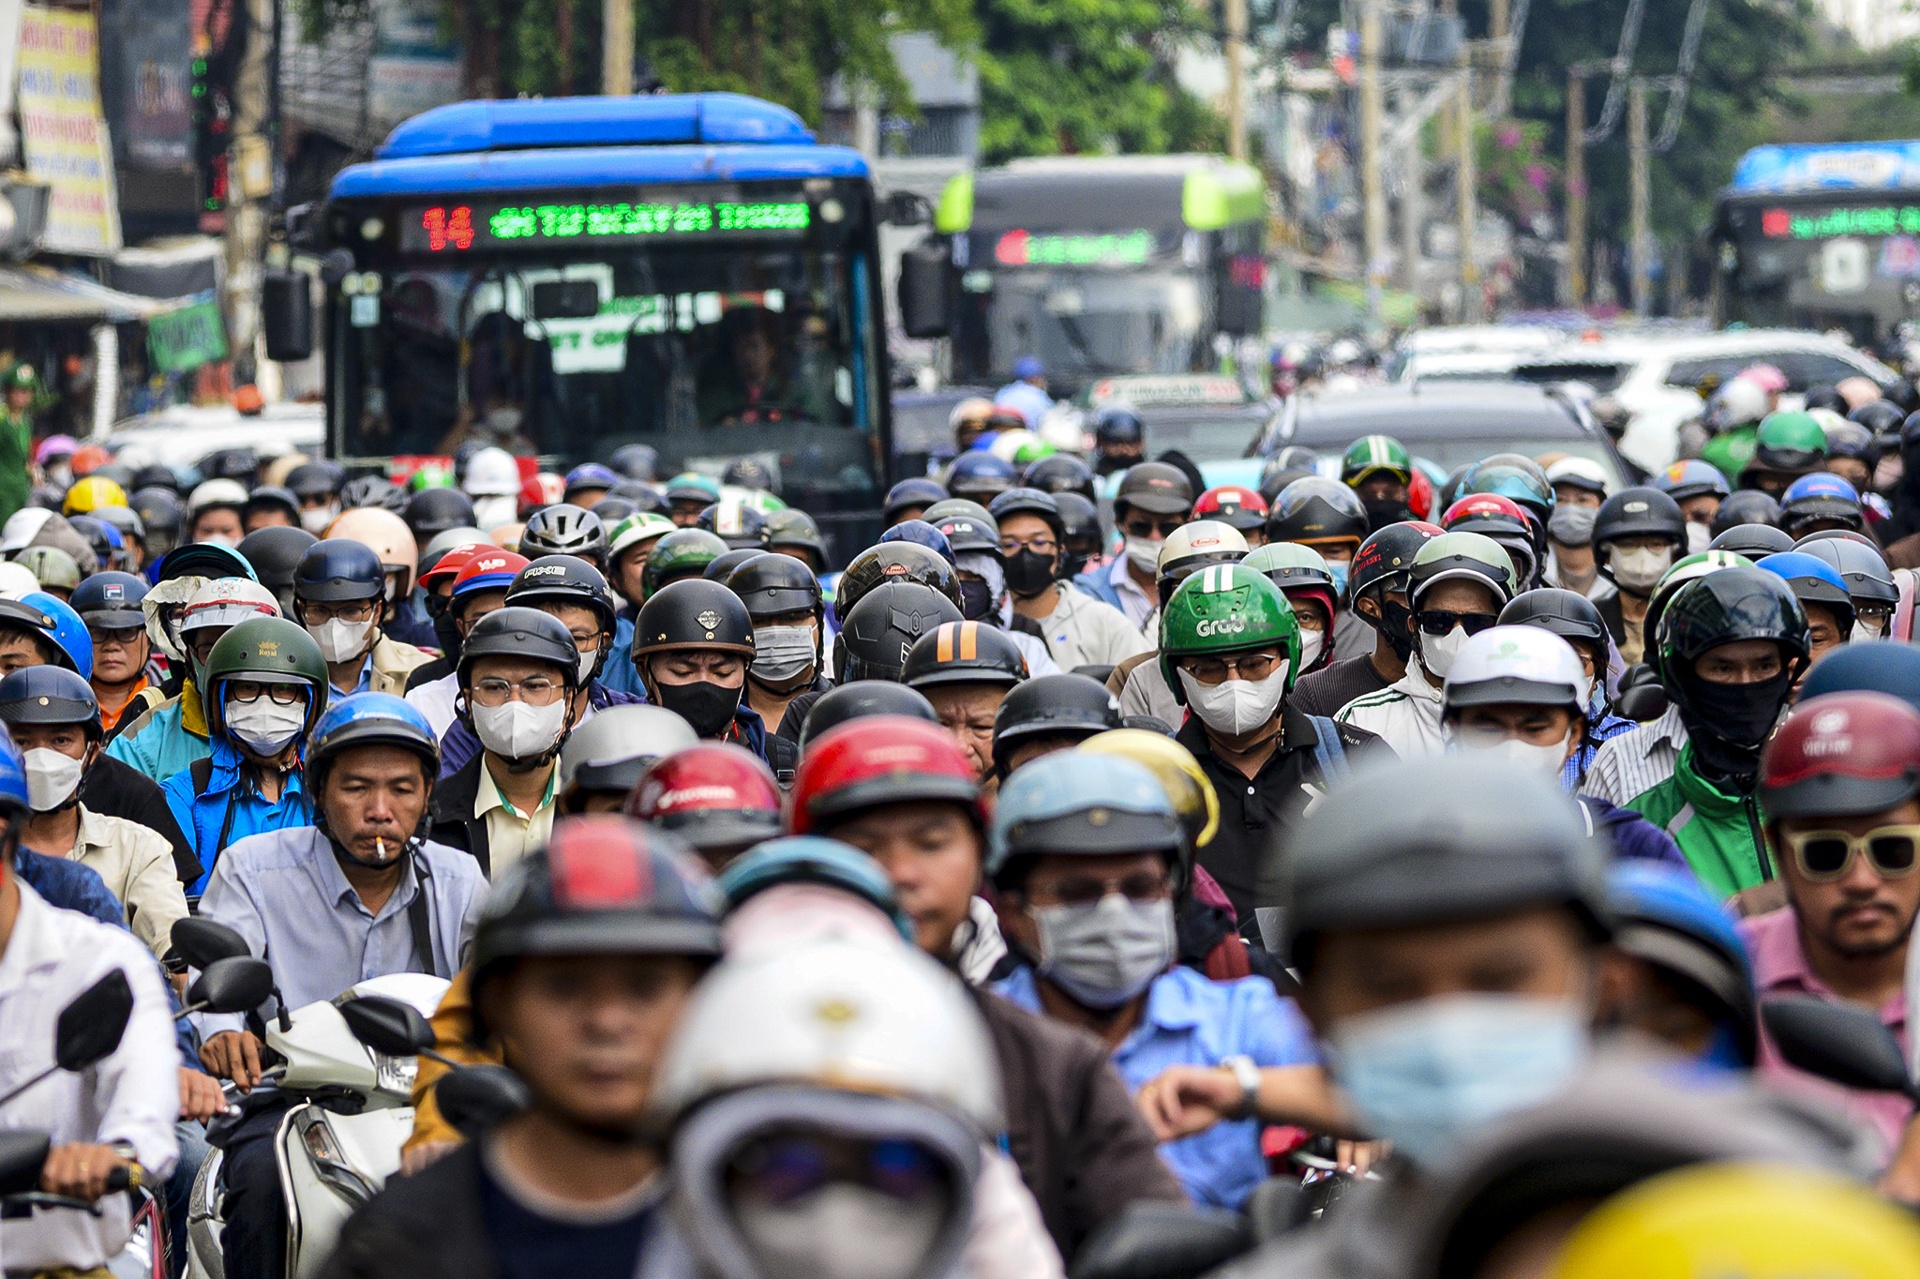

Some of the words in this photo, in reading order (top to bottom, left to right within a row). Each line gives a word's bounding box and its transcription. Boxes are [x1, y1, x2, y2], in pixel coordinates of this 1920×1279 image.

[423, 206, 474, 250] 14
[955, 523, 973, 532] LG
[1196, 613, 1245, 637] Grab
[258, 649, 277, 657] Royal
